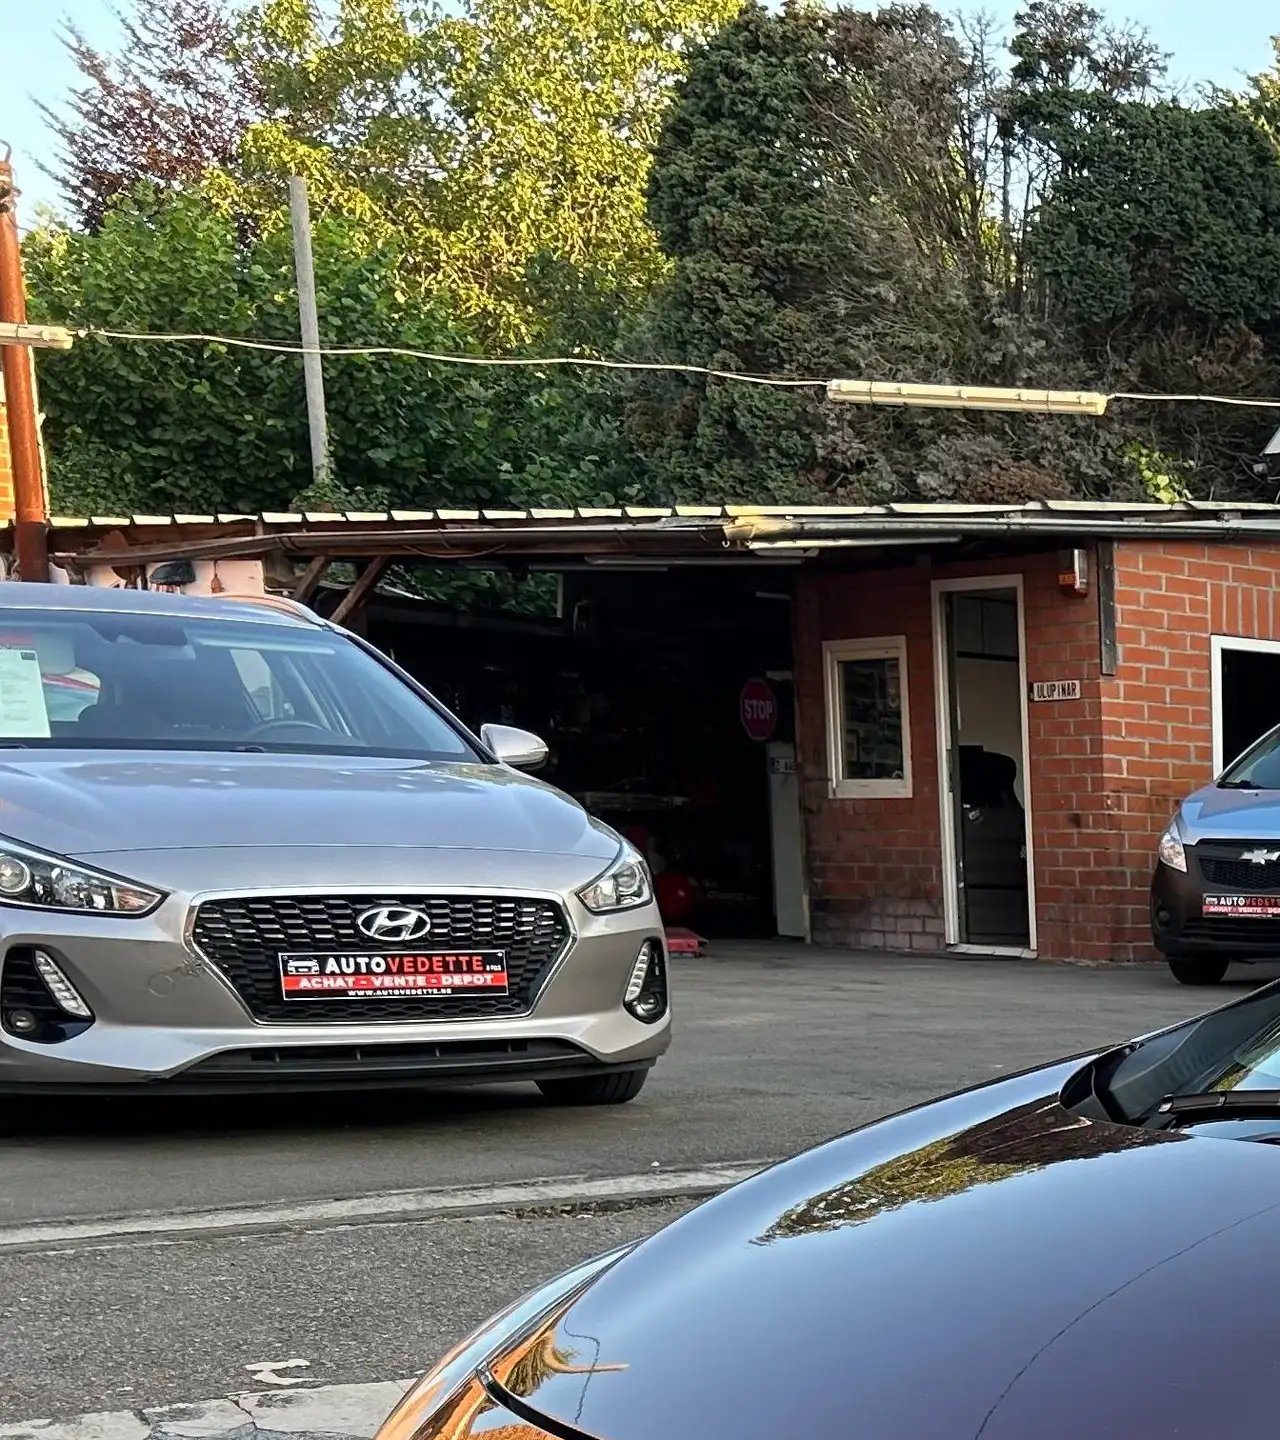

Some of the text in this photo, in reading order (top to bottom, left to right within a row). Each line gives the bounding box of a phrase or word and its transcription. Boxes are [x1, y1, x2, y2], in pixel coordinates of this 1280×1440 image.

[744, 699, 773, 719] STOP
[325, 955, 484, 974] AUTOVEDETTE
[299, 976, 356, 988] ACHAT
[371, 975, 427, 987] VENTE
[441, 974, 493, 985] DEPOT
